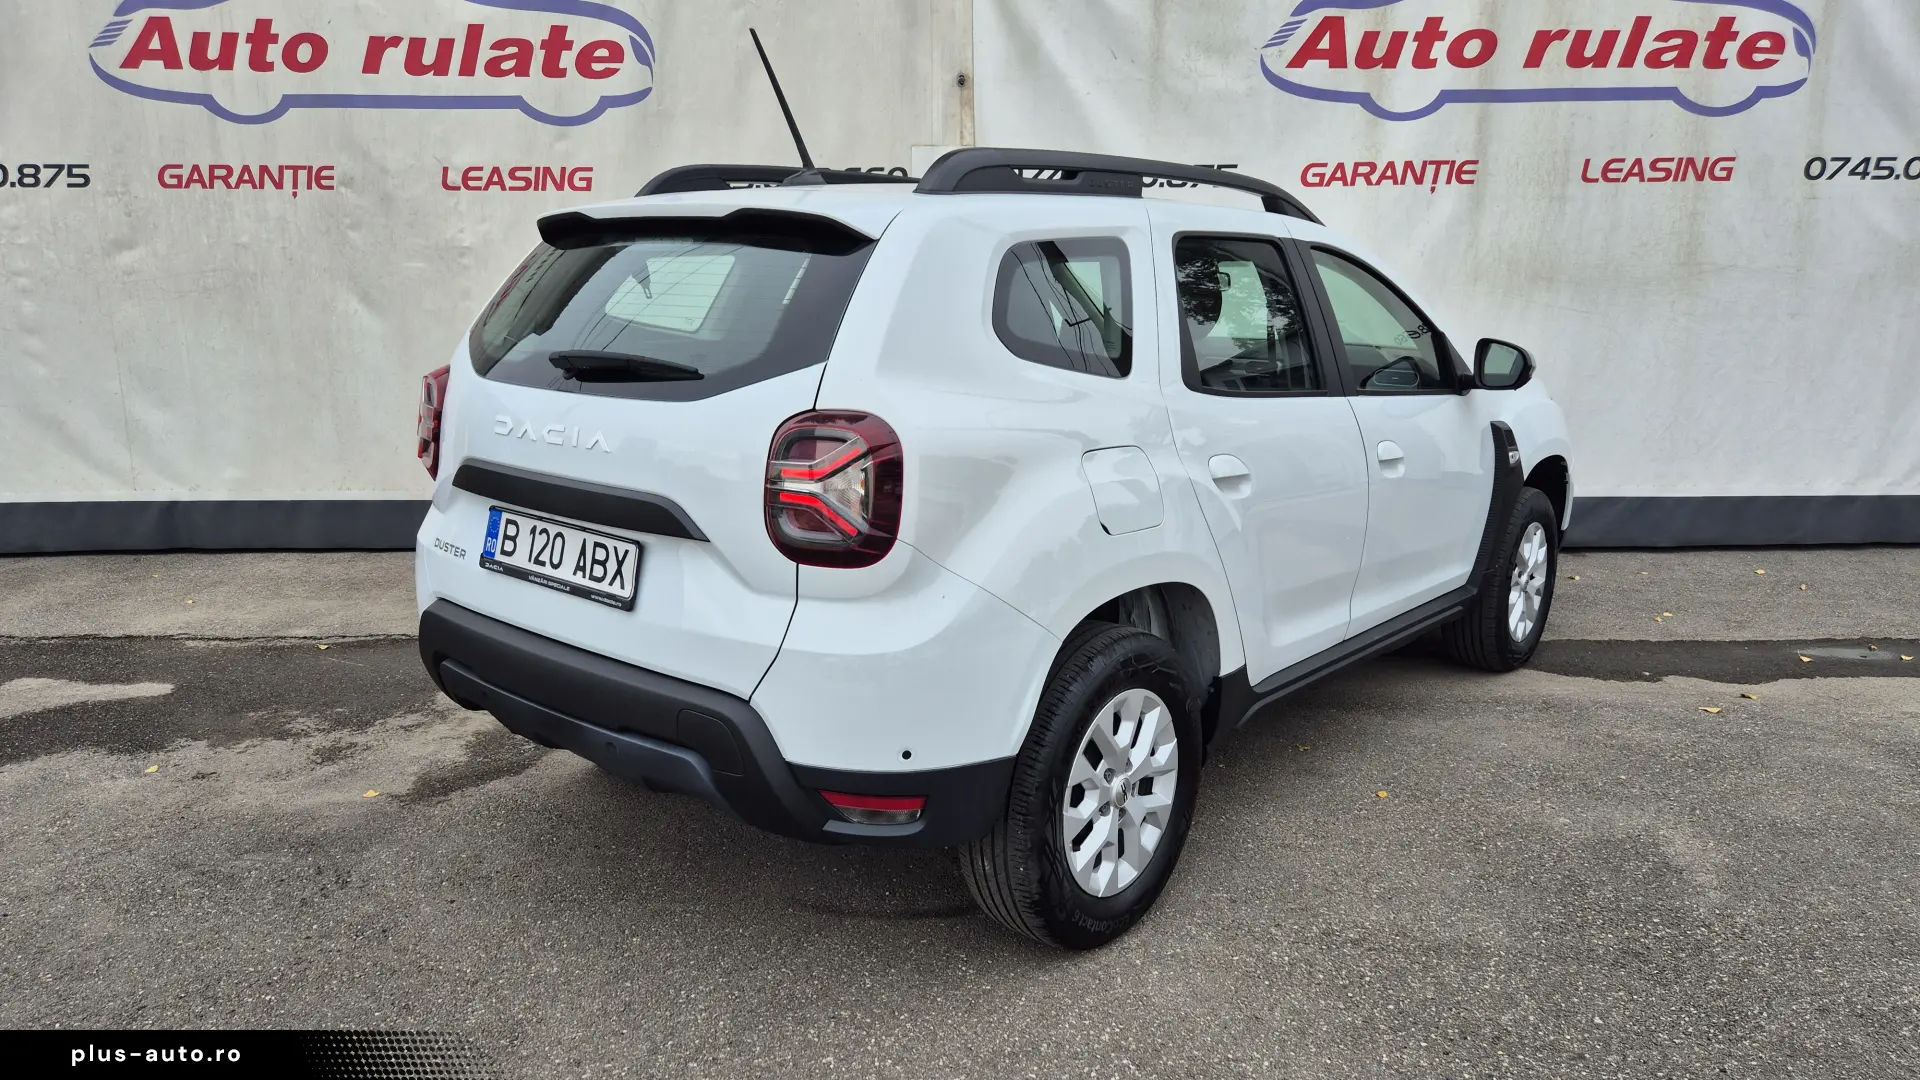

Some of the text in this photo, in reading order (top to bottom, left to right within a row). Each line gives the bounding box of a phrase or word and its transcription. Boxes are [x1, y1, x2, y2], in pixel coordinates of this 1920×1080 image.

[122, 16, 625, 80] Auto rulate
[1287, 15, 1787, 70] Auto rulate
[157, 164, 335, 198] GARANȚIE
[441, 166, 593, 192] LEASING
[1300, 159, 1479, 193] GARANȚIE
[1581, 156, 1736, 183] LEASING
[1803, 156, 1920, 181] 0745.0
[493, 414, 612, 453] DACIA
[434, 537, 467, 560] DUSTER
[485, 537, 498, 553] RO
[500, 517, 630, 590] B 120 ABX
